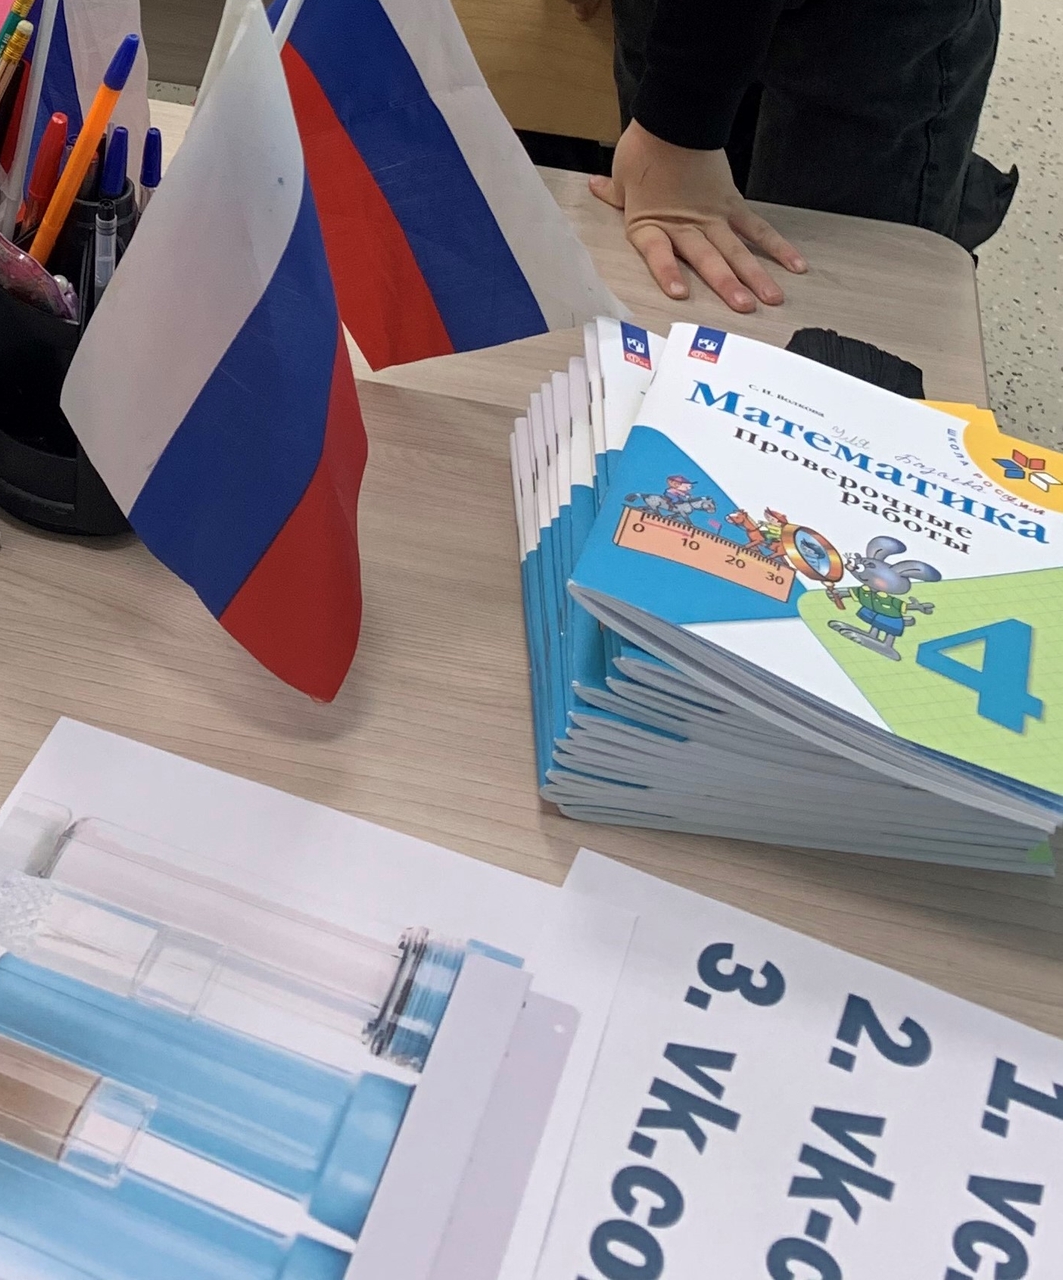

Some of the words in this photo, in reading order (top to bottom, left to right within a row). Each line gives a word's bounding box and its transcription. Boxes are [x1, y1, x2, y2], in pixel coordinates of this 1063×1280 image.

[685, 380, 1050, 544] Математика
[733, 426, 973, 539] Проверочные
[947, 428, 969, 466] ШКОЛА
[631, 522, 646, 534] 0
[681, 537, 701, 552] 10
[725, 554, 746, 570] 20
[765, 571, 785, 586] 30
[840, 492, 970, 556] работы
[916, 618, 1044, 736] 4
[684, 942, 786, 1011] 3.
[828, 993, 932, 1073] 2.
[981, 1057, 1063, 1138] 1.
[575, 1042, 742, 1280] vk.co
[766, 1106, 895, 1280] vk-c
